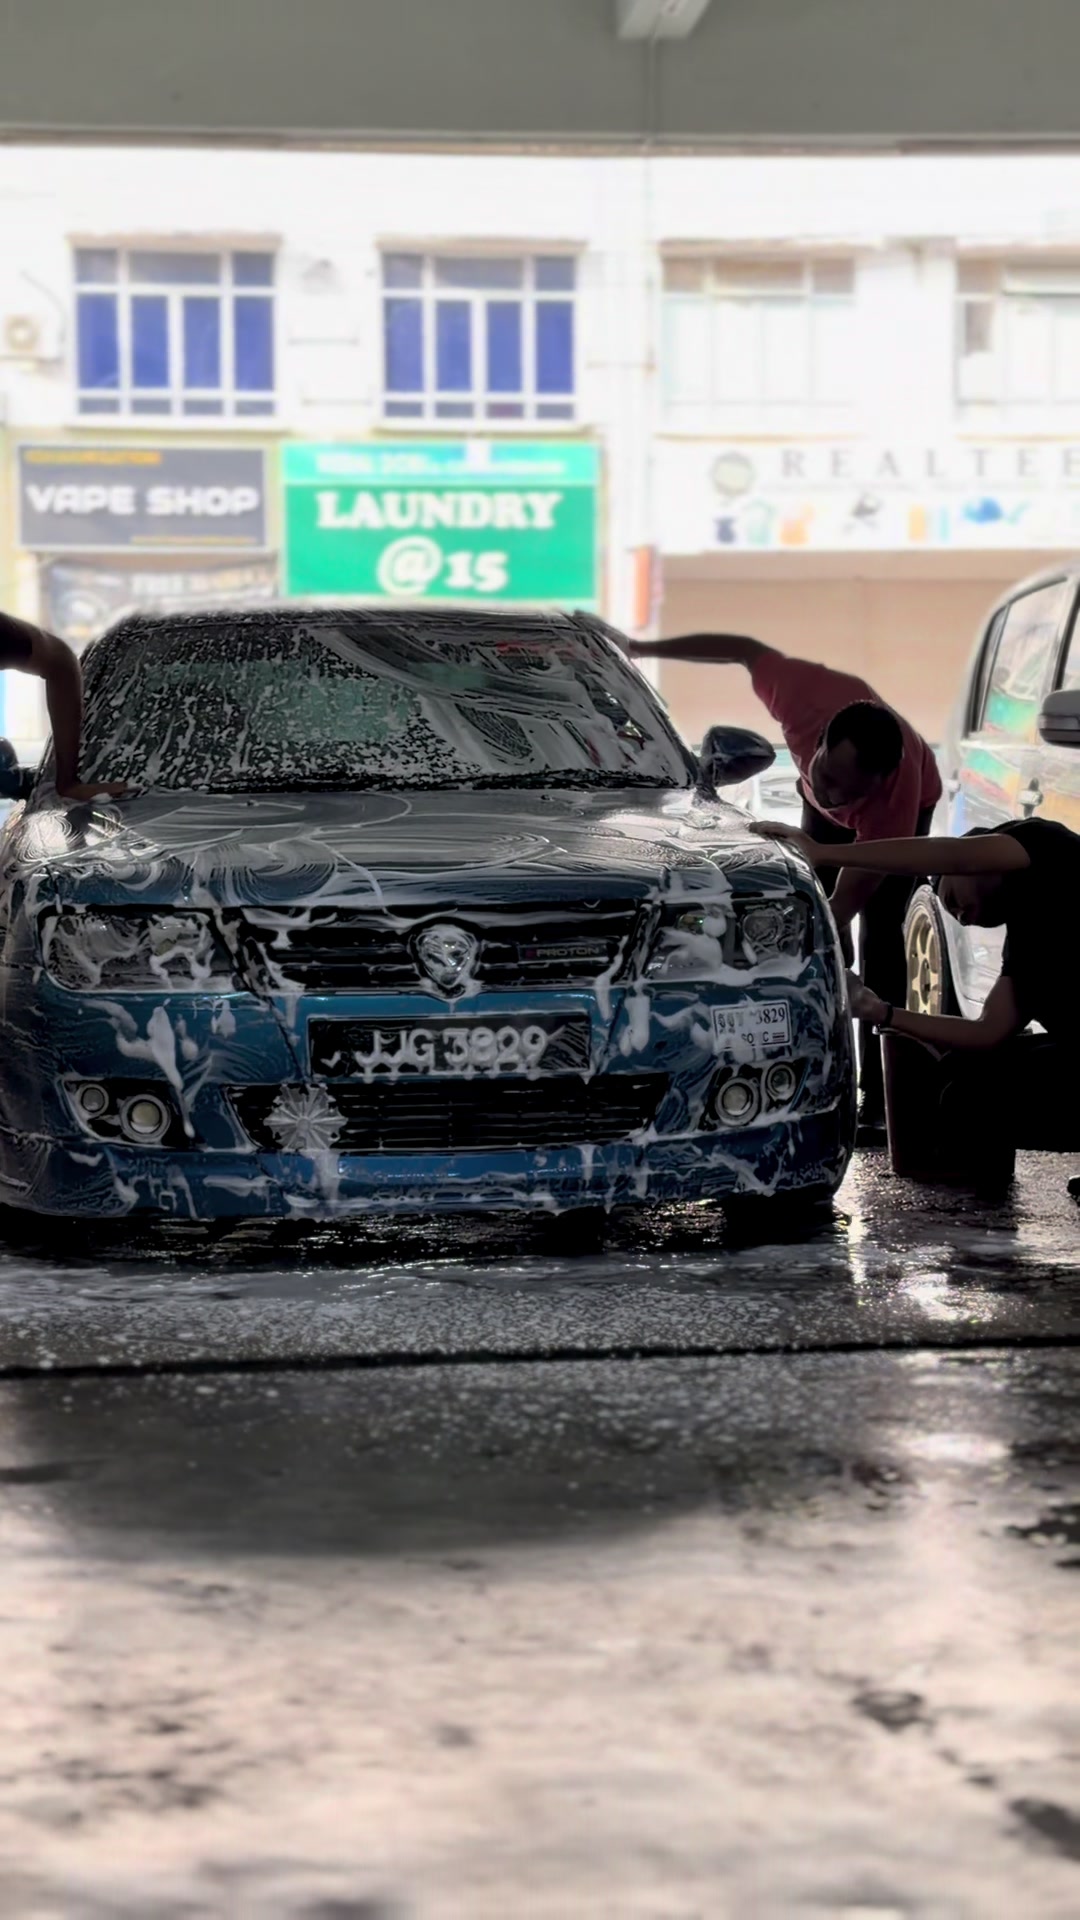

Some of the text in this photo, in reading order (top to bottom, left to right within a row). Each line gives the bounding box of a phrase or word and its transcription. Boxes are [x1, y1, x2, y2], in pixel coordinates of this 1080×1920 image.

[26, 484, 260, 516] VAPE SHOP
[315, 491, 563, 529] LAUNDRY
[377, 535, 508, 595] @15
[536, 946, 600, 957] PROTON
[355, 1026, 549, 1068] JJG 3829
